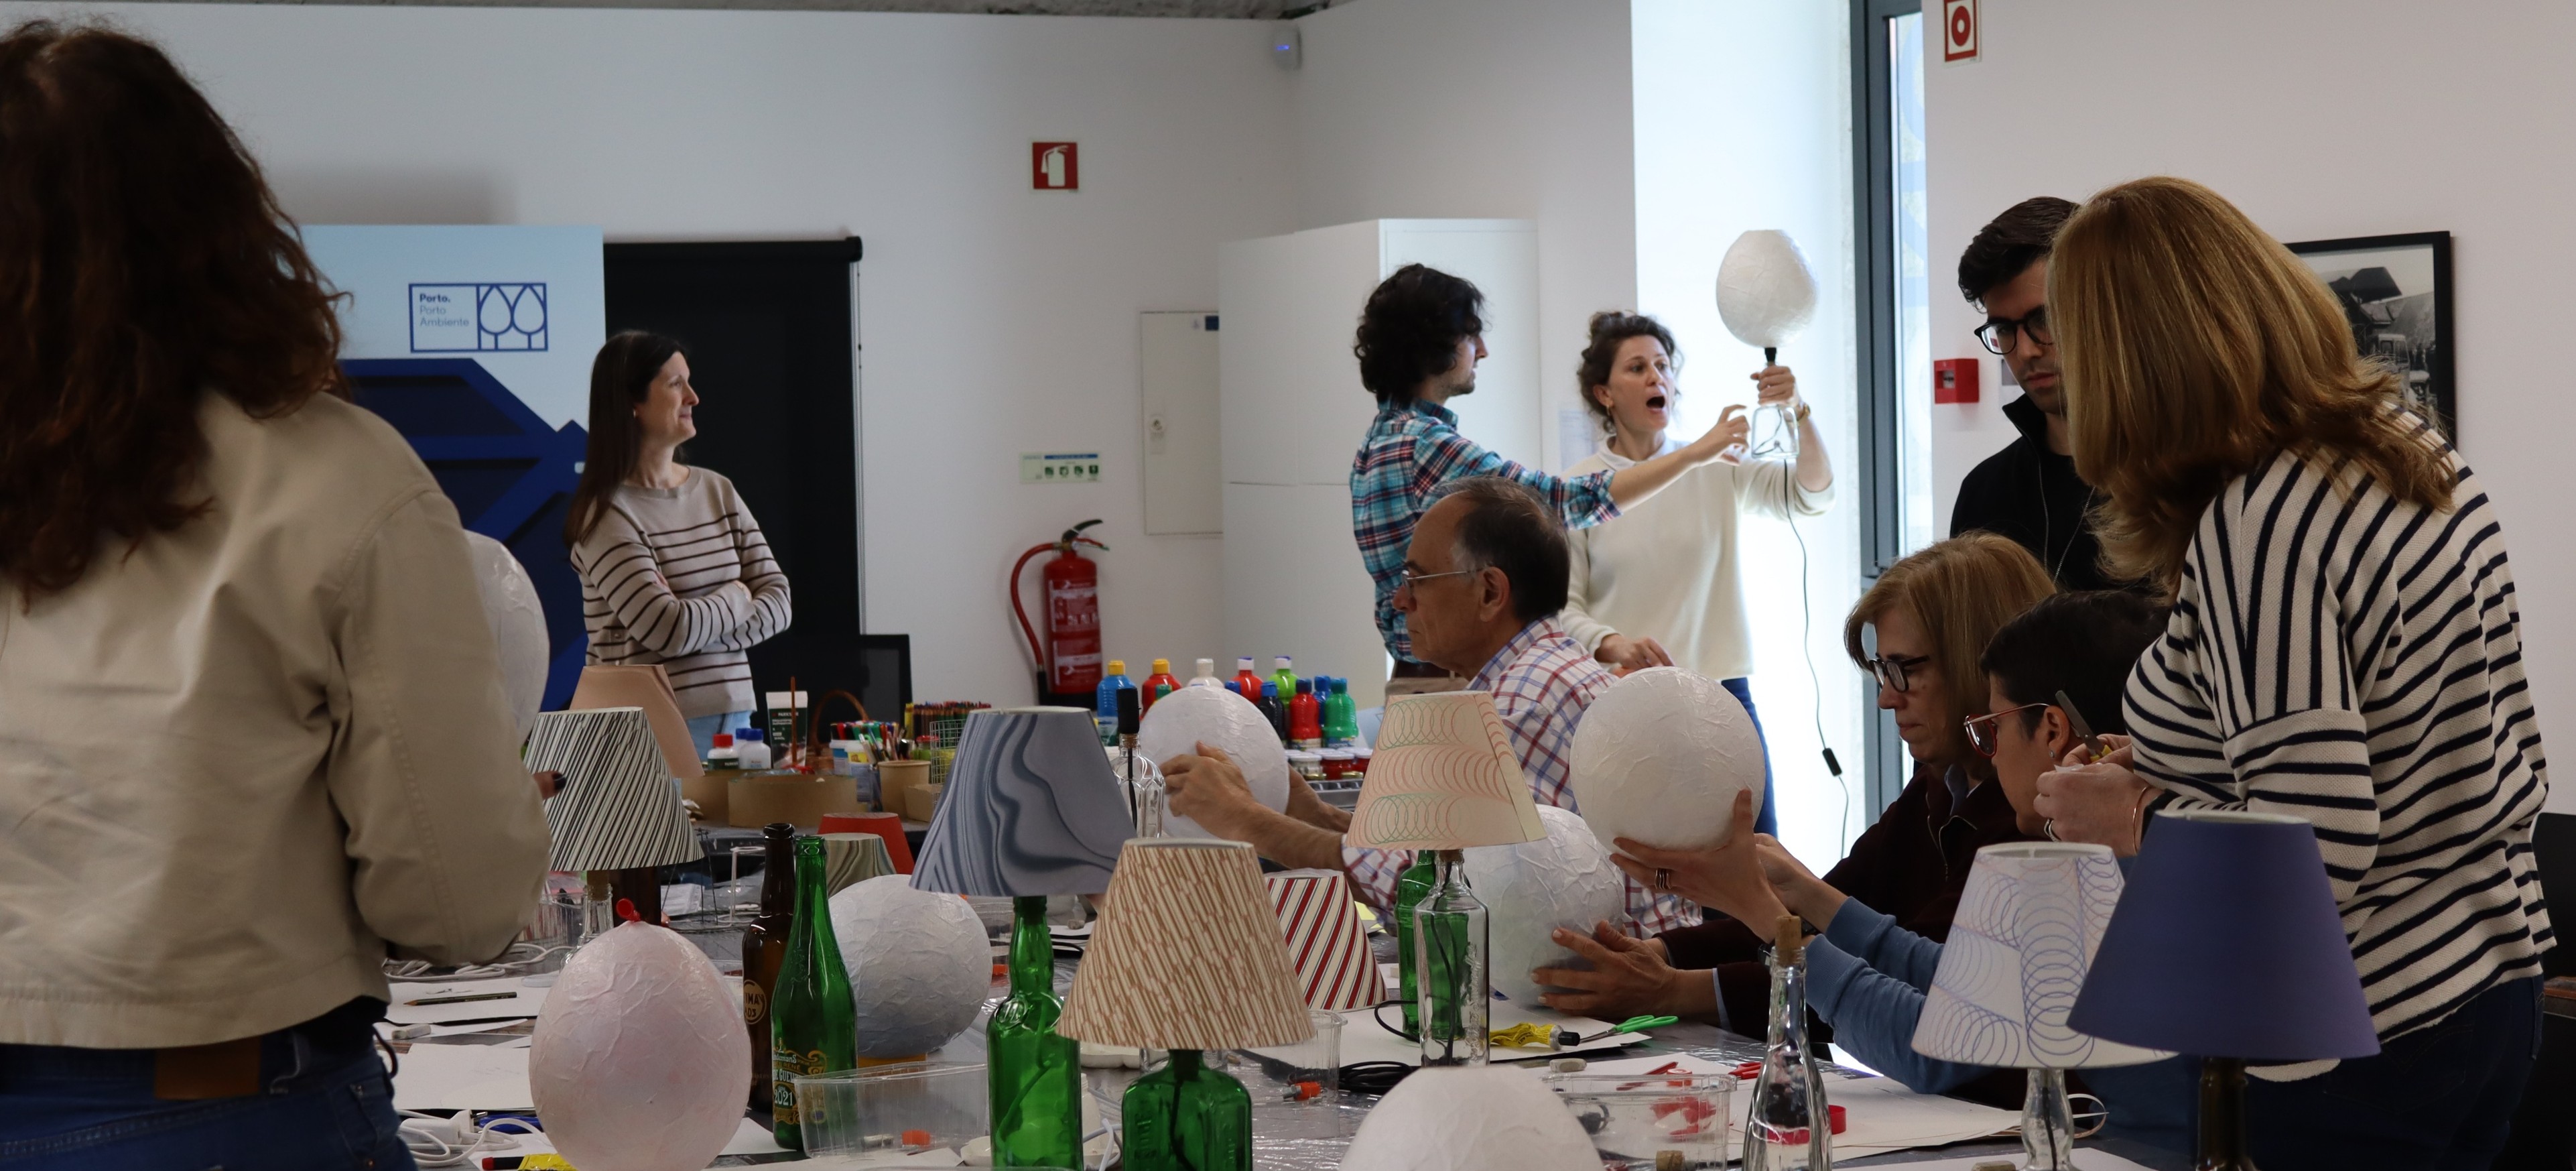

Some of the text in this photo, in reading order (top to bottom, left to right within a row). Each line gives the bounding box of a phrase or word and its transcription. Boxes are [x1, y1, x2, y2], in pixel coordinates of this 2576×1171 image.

[420, 294, 451, 302] Porto.
[420, 305, 446, 314] Porto
[420, 317, 469, 326] Ambiente
[774, 1089, 793, 1106] 2021
